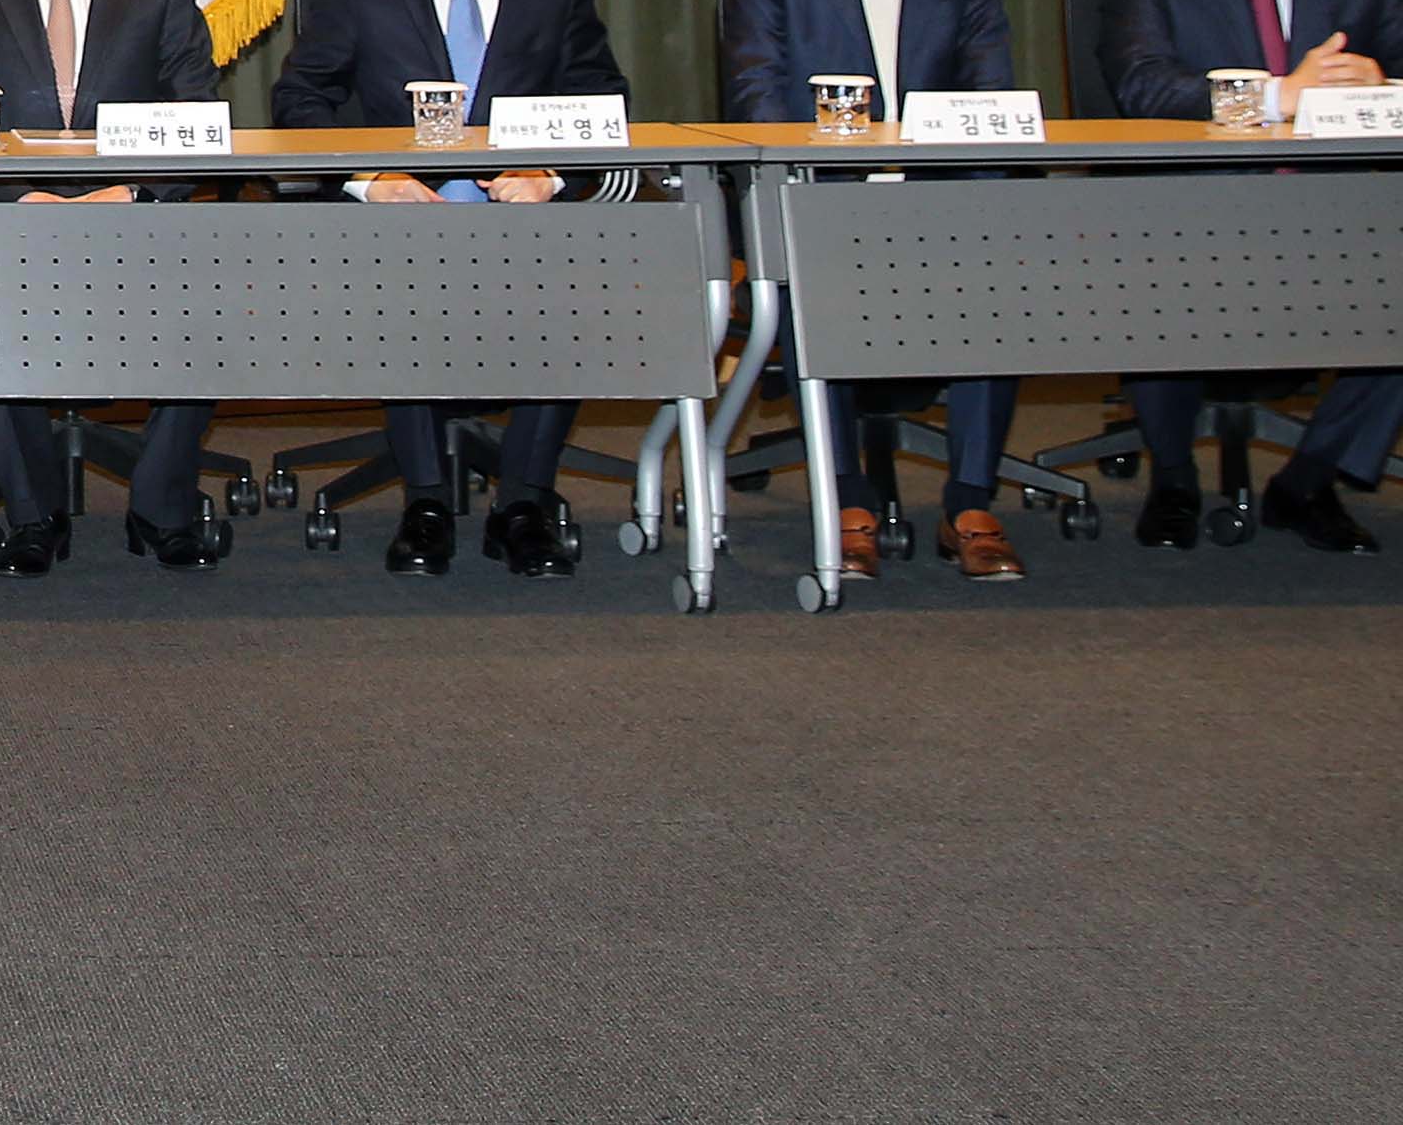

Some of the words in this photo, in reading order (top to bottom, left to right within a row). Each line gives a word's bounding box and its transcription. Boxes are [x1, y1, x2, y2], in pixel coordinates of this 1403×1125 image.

[546, 117, 622, 141] 신영선
[959, 113, 1036, 136] 김원남
[147, 125, 224, 148] 하현회
